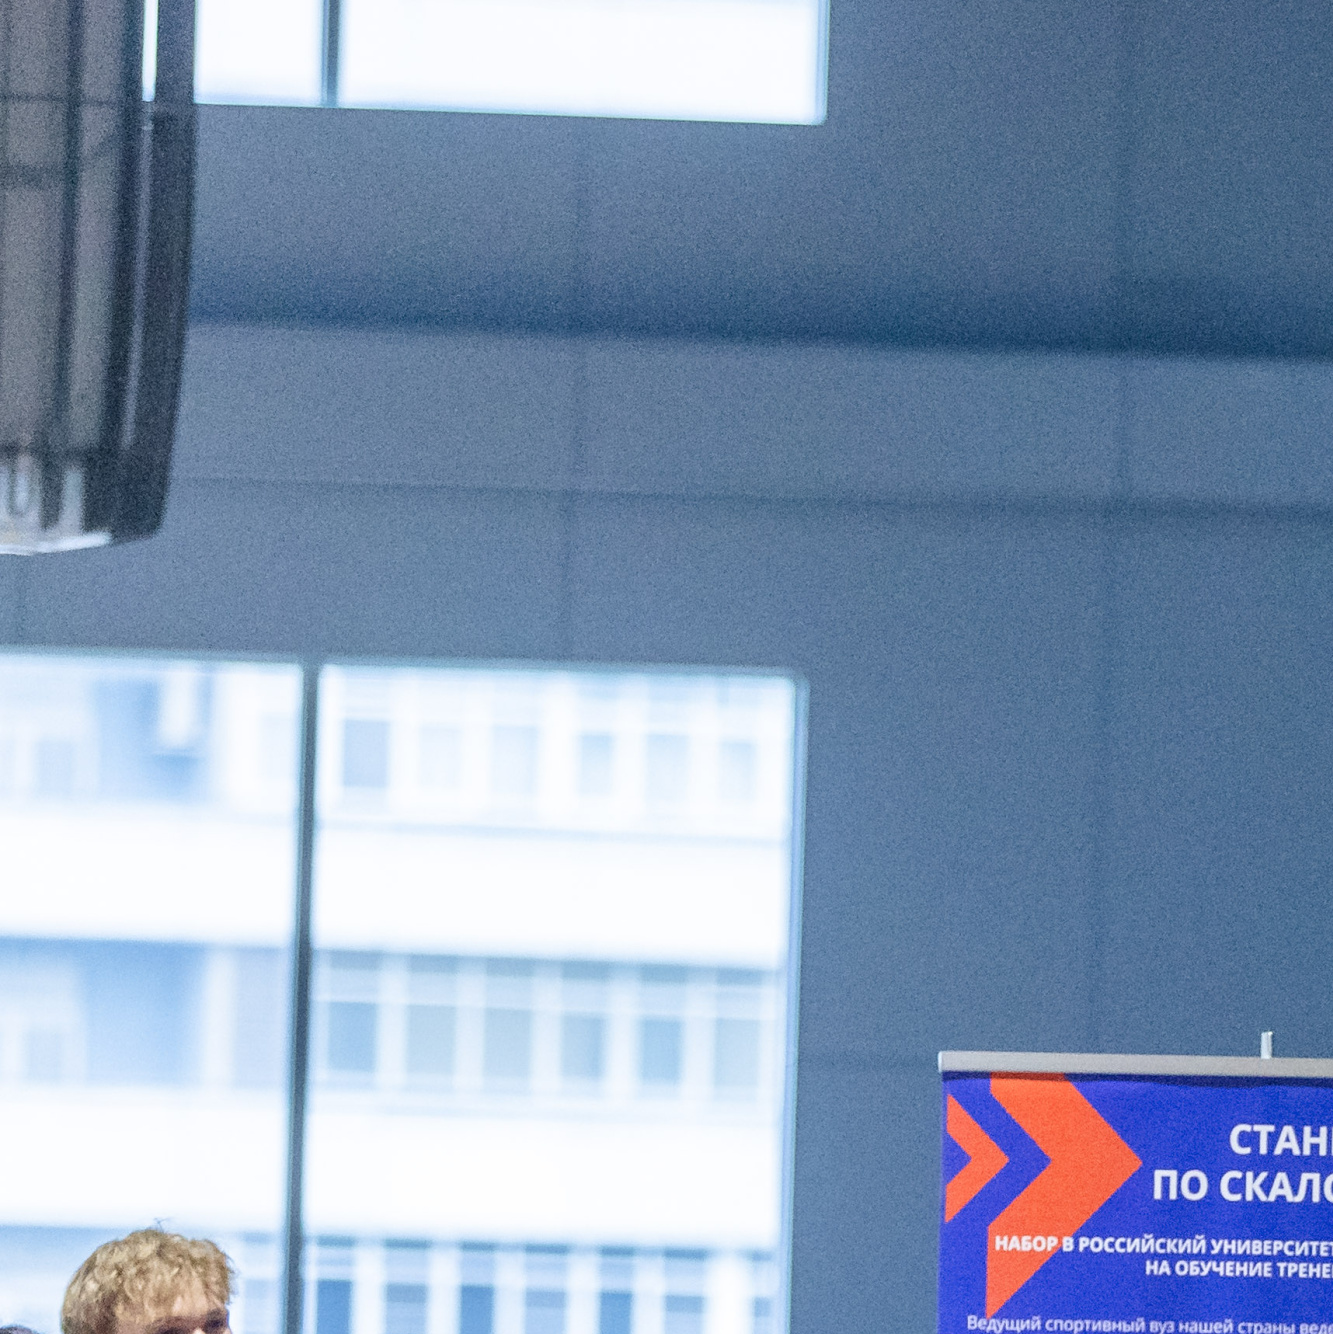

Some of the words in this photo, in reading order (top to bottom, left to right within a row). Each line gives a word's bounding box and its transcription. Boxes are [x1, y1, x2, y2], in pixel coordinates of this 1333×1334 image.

[1153, 1168, 1209, 1200] ПО
[994, 1235, 1059, 1251] НАБОР
[1062, 1236, 1074, 1251] В
[1078, 1235, 1206, 1253] РОССИЙСКИЙ
[1145, 1259, 1172, 1275] НА
[1174, 1259, 1273, 1277] ОБУЧЕНИЕ
[966, 1315, 1042, 1334] Ведущий
[1044, 1317, 1146, 1334] спортивный
[1178, 1318, 1234, 1334] нашей
